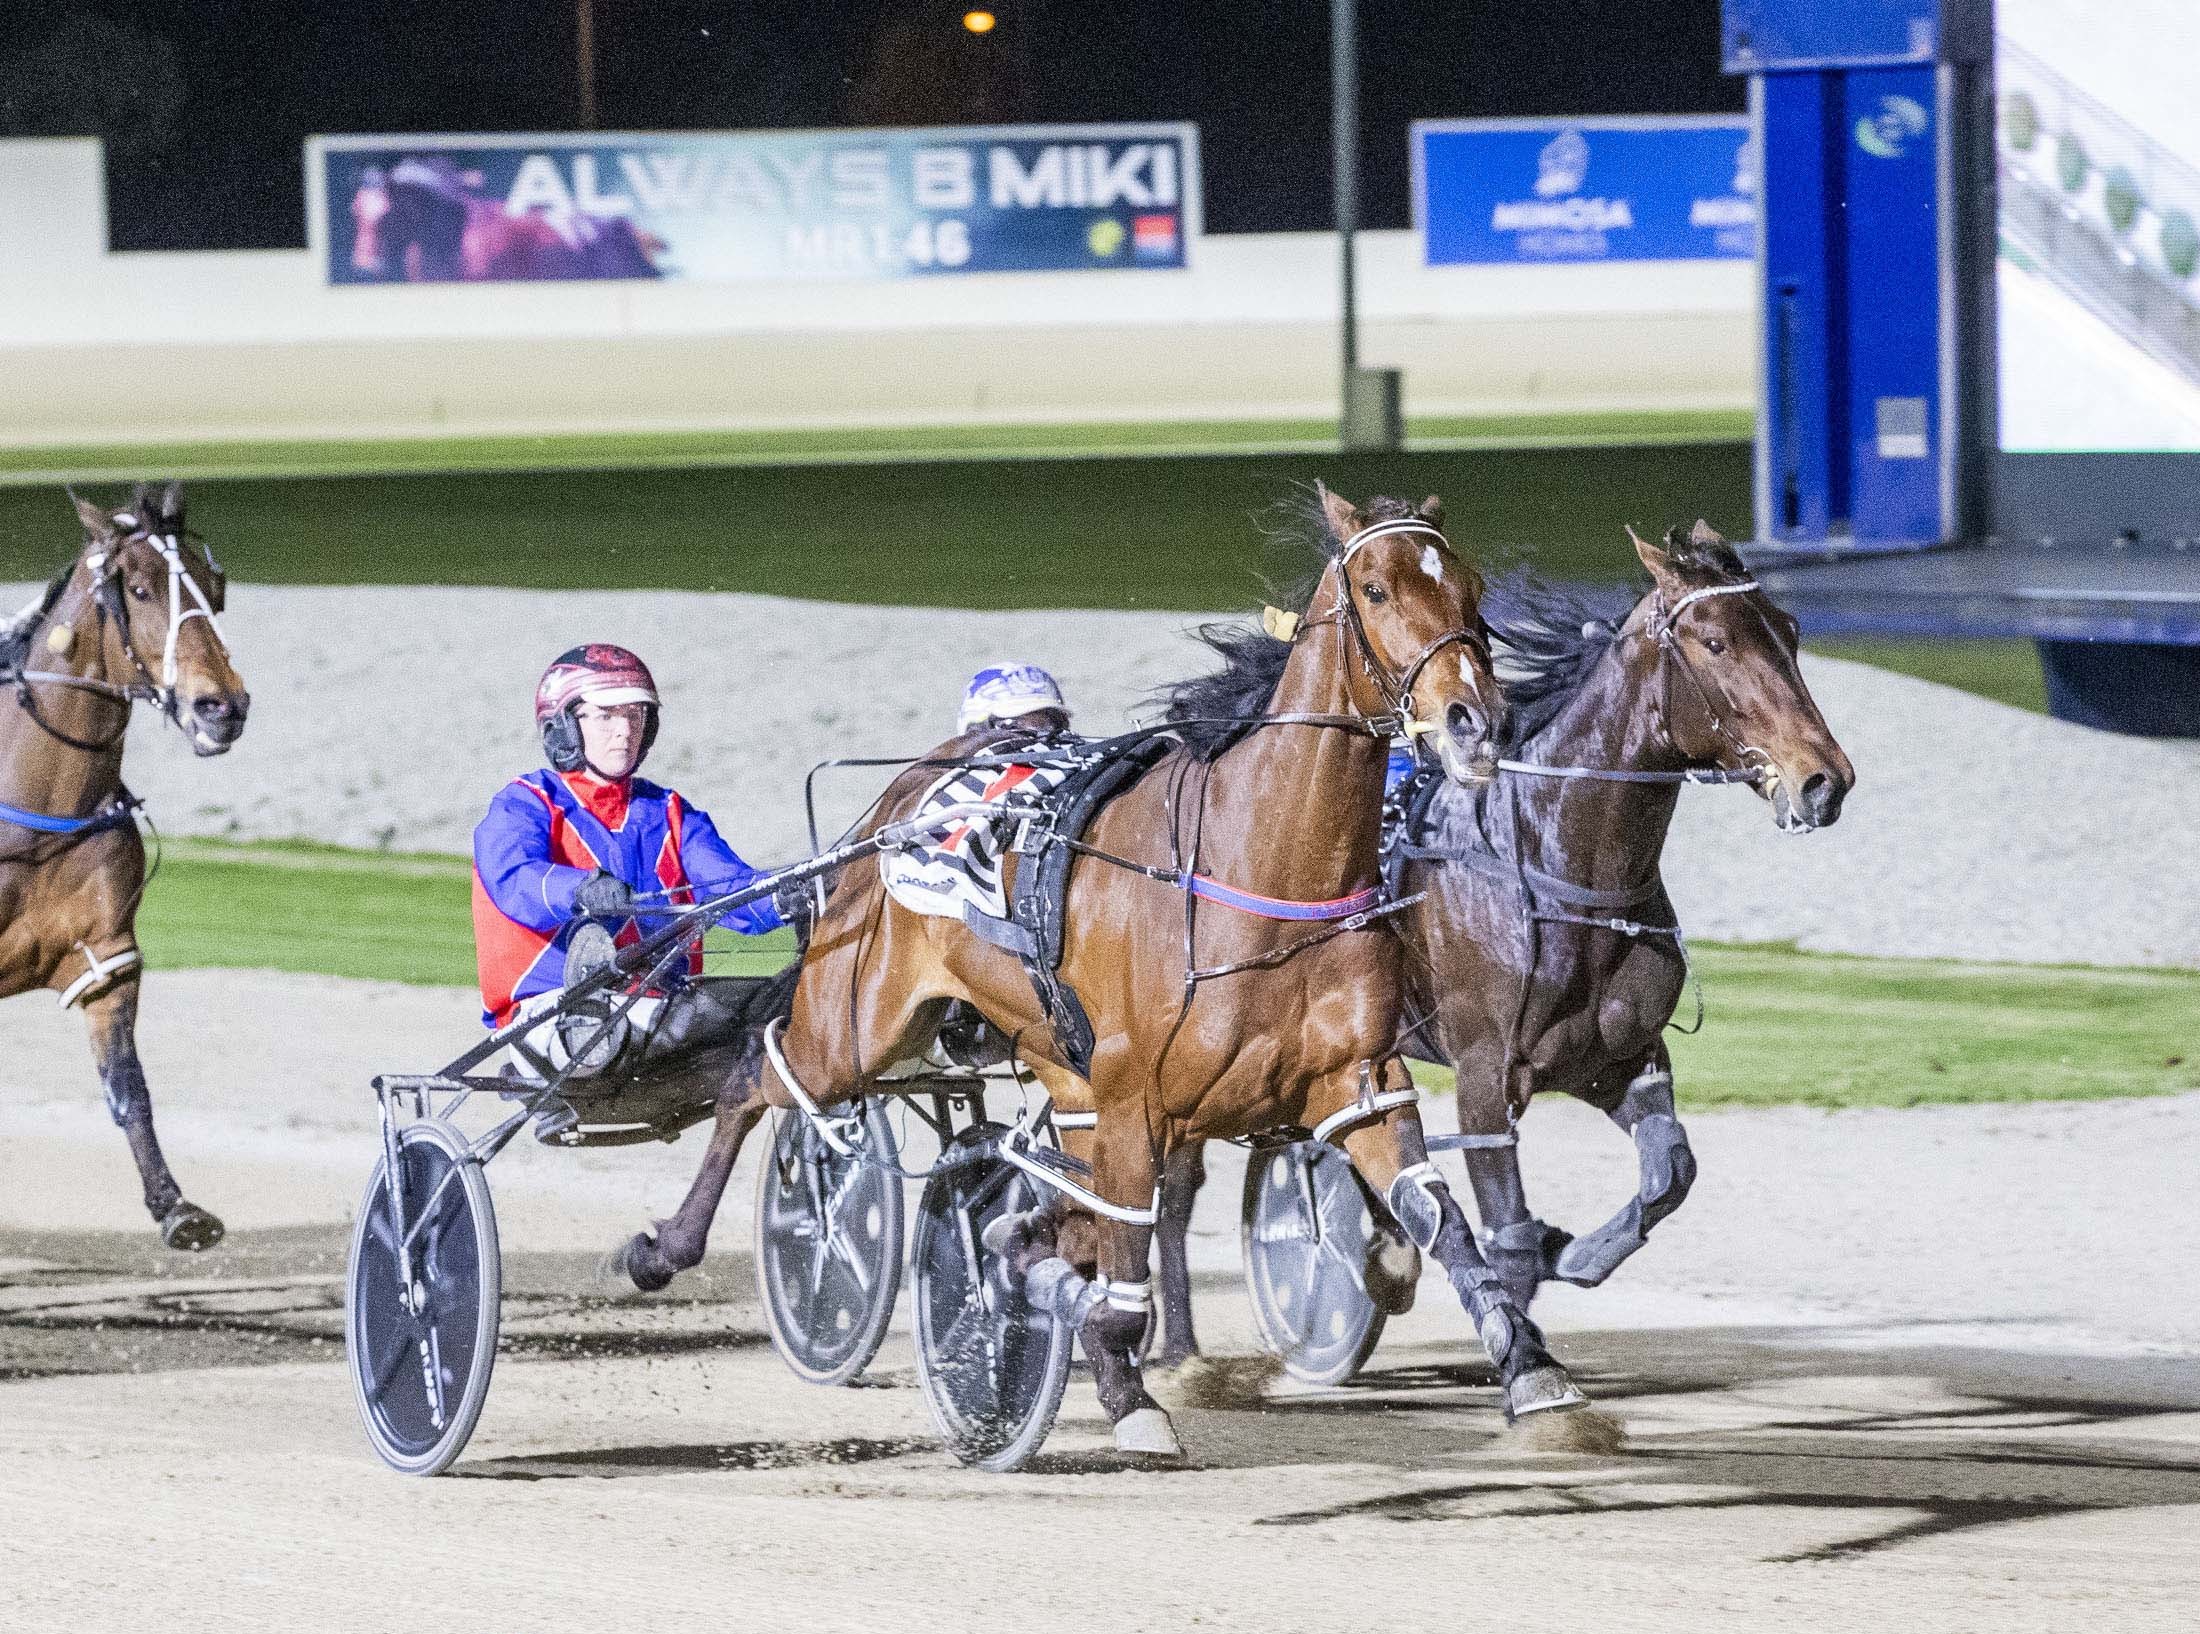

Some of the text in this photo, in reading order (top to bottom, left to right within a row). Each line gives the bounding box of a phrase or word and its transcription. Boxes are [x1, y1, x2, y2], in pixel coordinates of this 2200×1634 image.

[506, 145, 1177, 216] ALWAYS B MIKI
